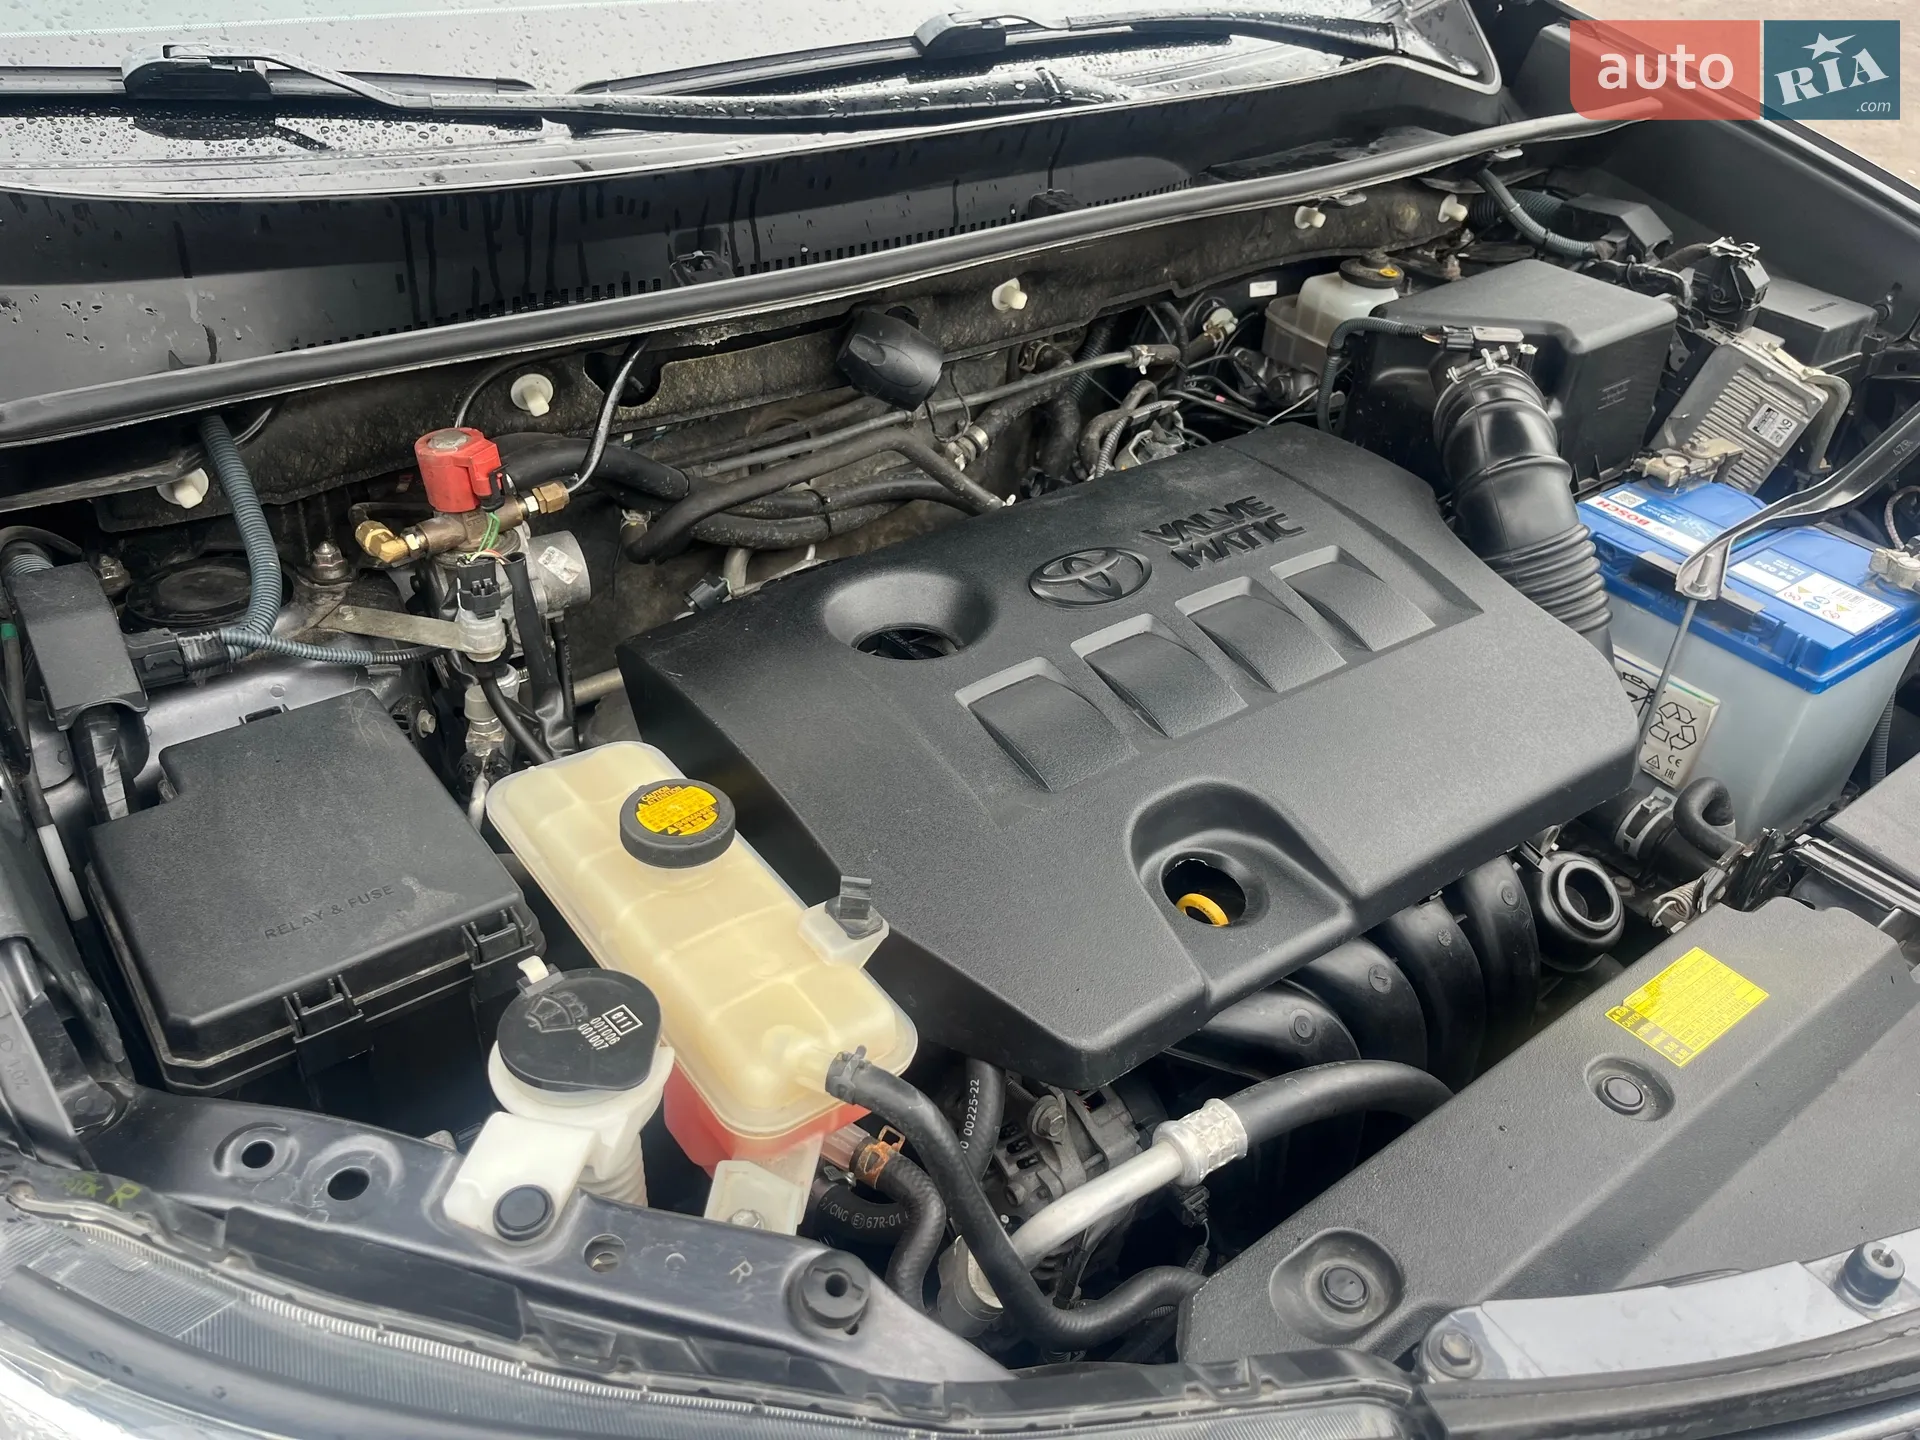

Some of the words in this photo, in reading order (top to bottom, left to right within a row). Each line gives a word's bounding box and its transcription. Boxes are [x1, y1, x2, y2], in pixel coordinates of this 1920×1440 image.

[1140, 495, 1277, 547] VALVE
[1596, 499, 1651, 526] BOSCH
[1170, 512, 1307, 571] MATIC
[641, 785, 671, 802] CAUTION
[264, 909, 325, 940] RELAY
[331, 904, 344, 916] &
[347, 885, 396, 909] FUSE
[578, 1022, 610, 1051] 001007
[589, 1016, 621, 1046] 001006
[963, 1077, 981, 1137] 00225-22
[866, 1212, 901, 1229] 67R-01
[729, 1259, 754, 1284] R
